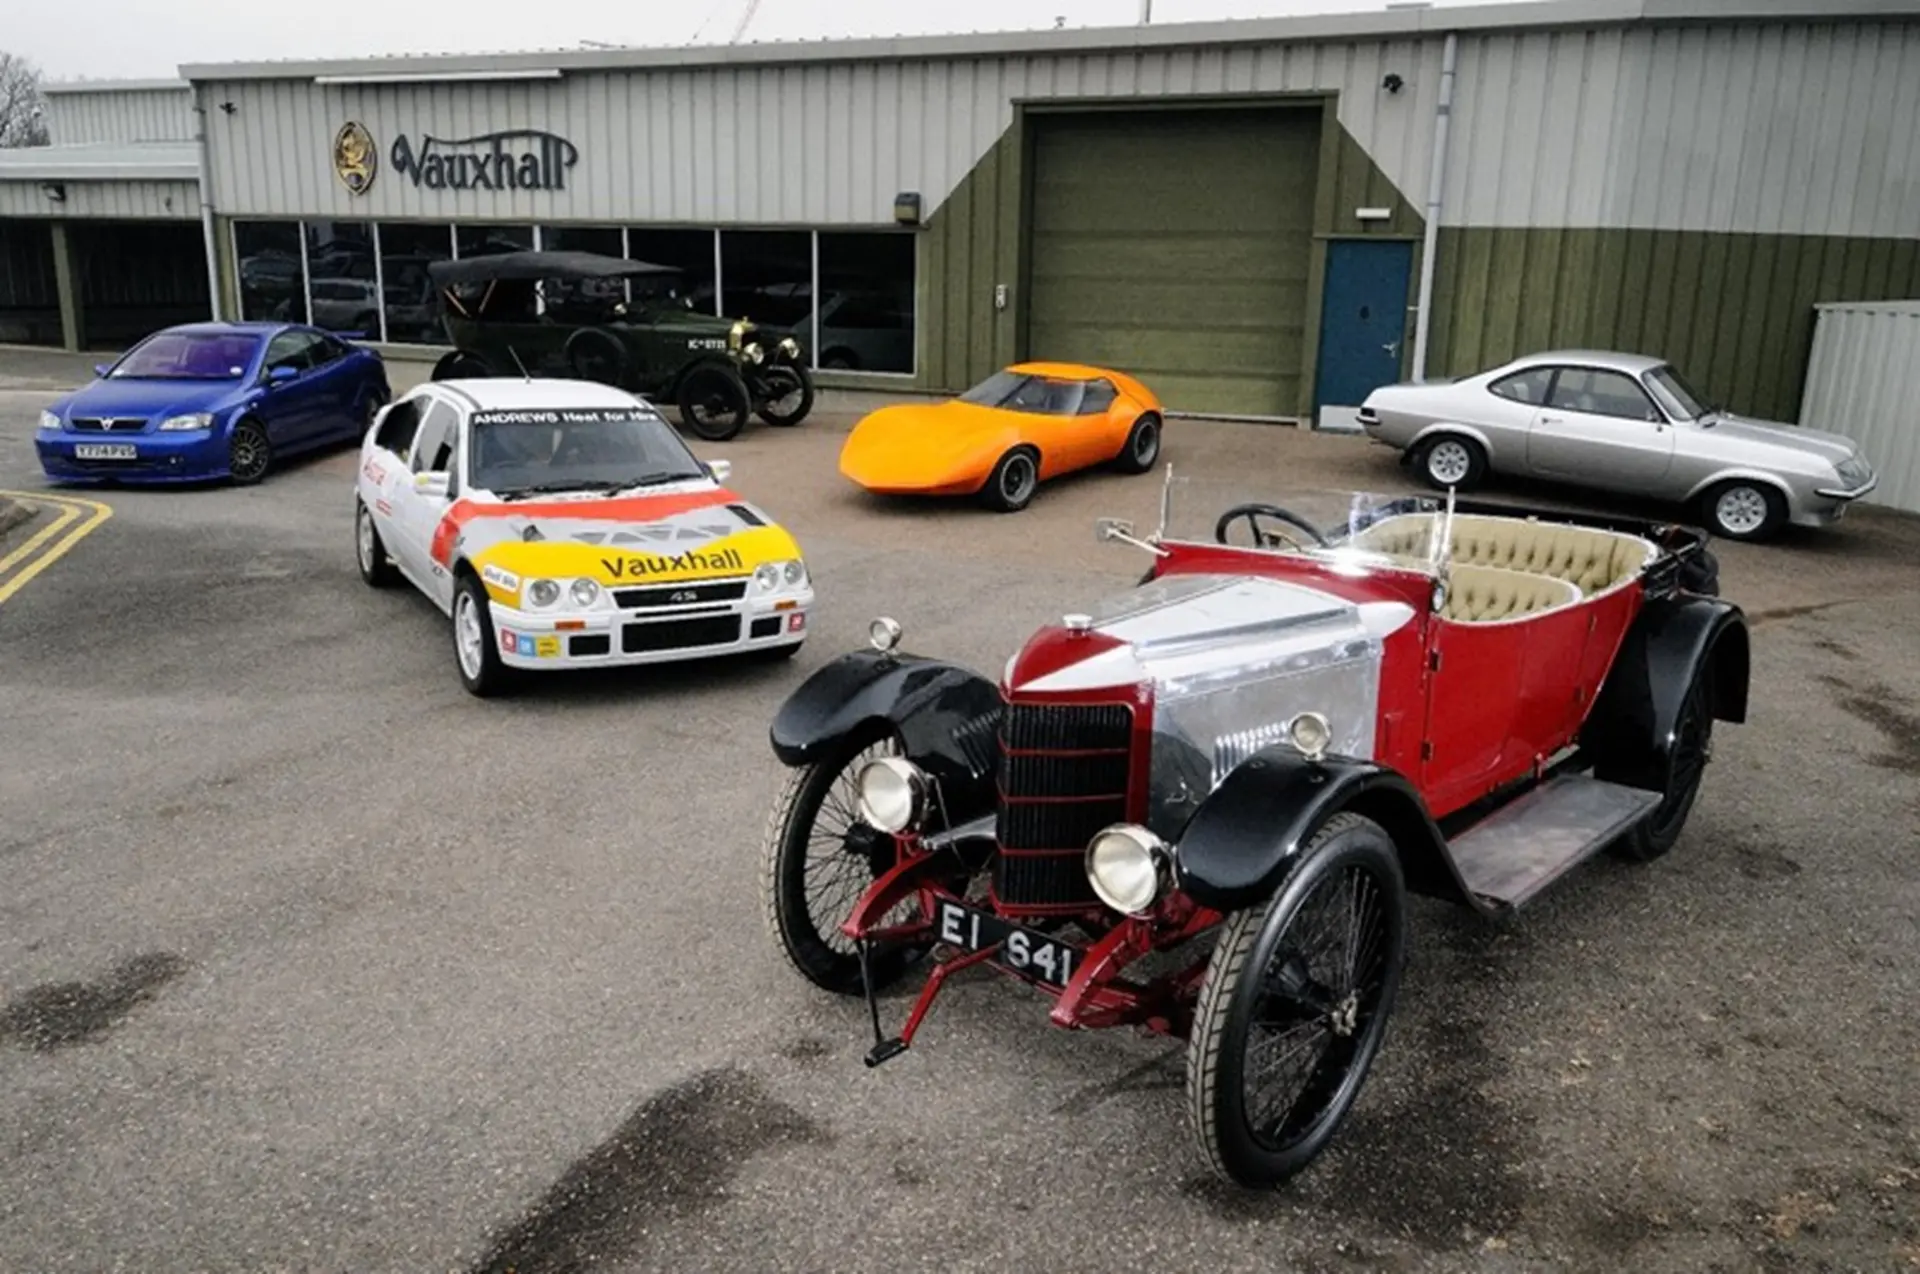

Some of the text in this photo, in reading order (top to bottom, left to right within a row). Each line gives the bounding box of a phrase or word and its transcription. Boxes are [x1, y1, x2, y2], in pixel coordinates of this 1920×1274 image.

[390, 130, 579, 190] Vauxhall
[474, 411, 559, 425] ANDREWS
[600, 548, 743, 579] Vauxhall
